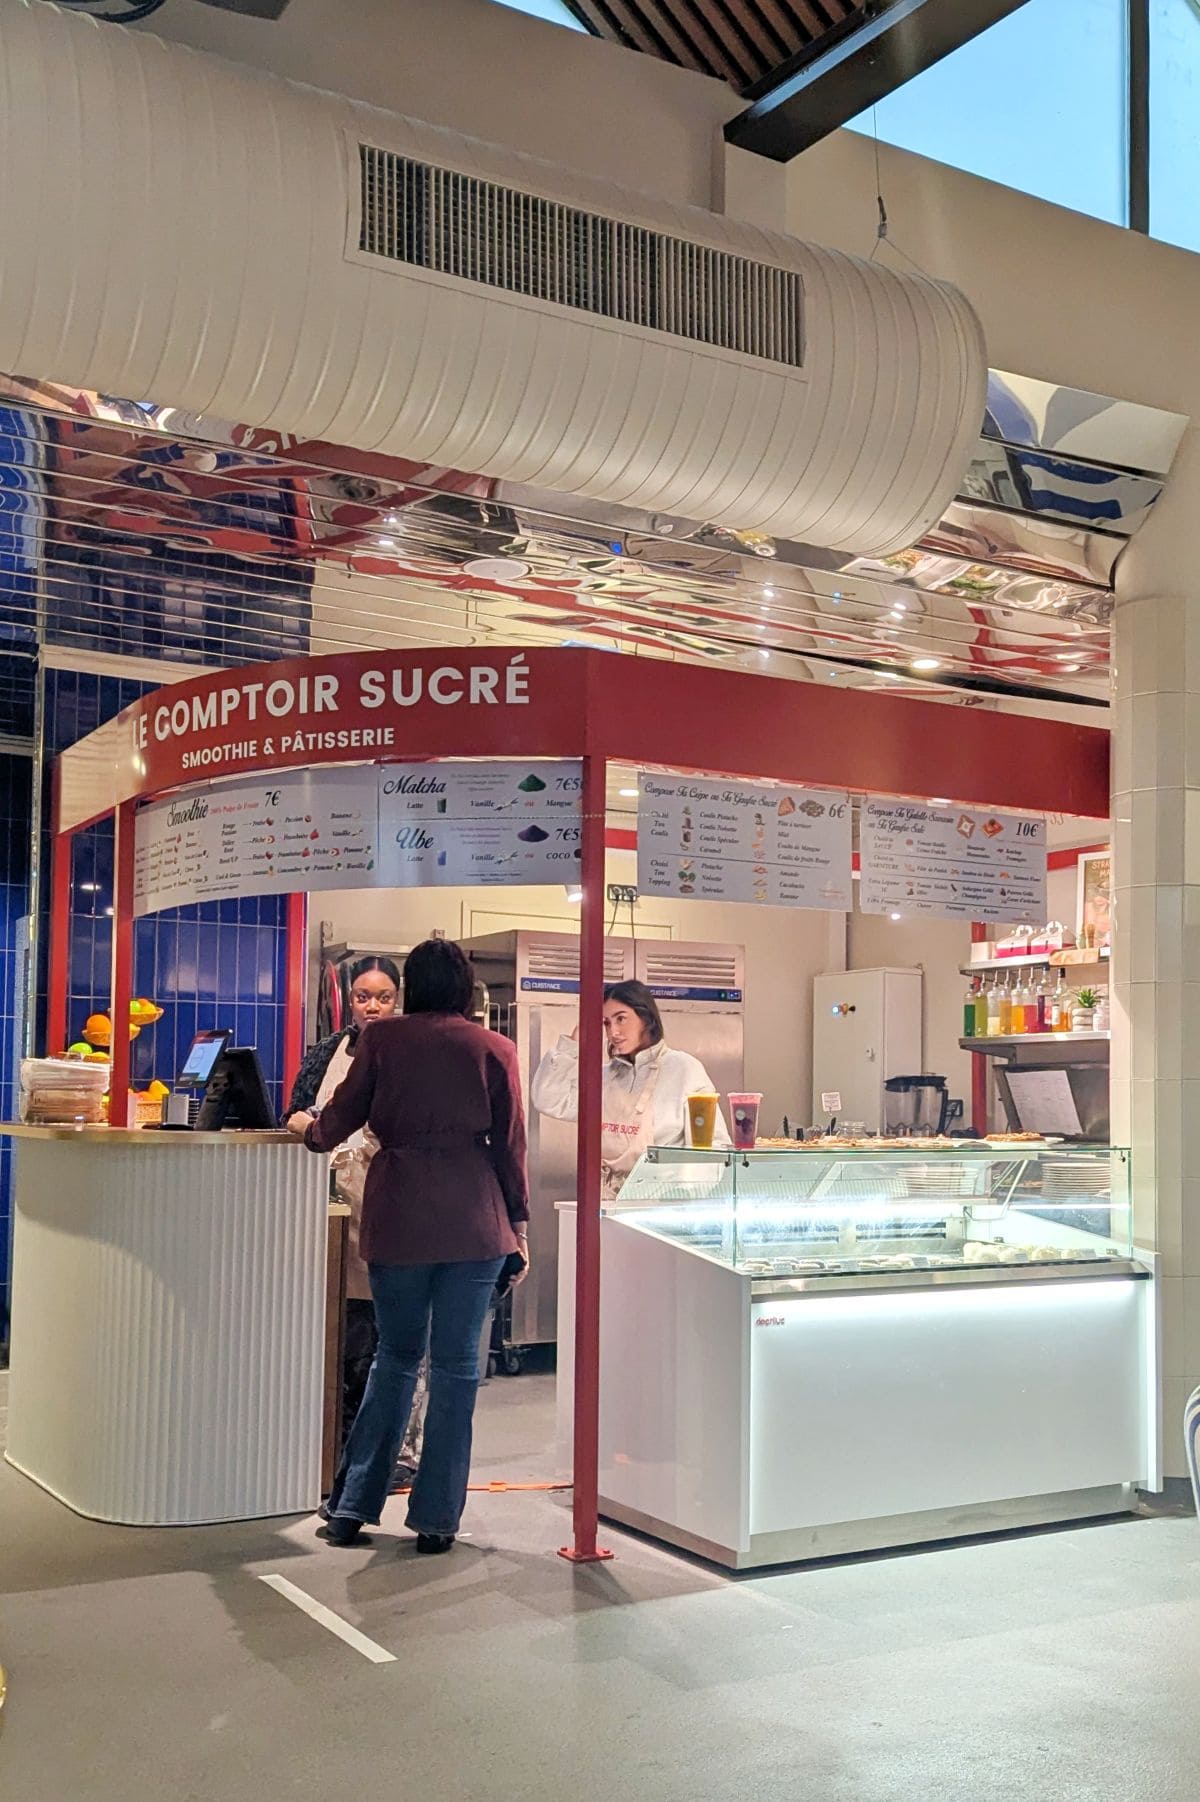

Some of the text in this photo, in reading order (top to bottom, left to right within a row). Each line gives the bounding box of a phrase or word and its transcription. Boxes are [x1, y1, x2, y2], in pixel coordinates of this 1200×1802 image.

[132, 653, 530, 752] LE COMPTOIR SUCRÉ
[182, 727, 395, 769] SMOOTHIE & PÂTISSERIE
[383, 775, 447, 794] Matcha
[555, 777, 583, 791] 7€5
[644, 782, 675, 798] Compose
[265, 790, 281, 807] 7€
[407, 801, 424, 809] Latte
[470, 800, 494, 808] Vanille
[546, 800, 573, 808] Mangue
[167, 798, 209, 827] Smoothie
[829, 803, 847, 818] 6€
[868, 804, 894, 817] Compose
[555, 828, 582, 841] 7€5
[1016, 822, 1039, 837] 10€
[396, 826, 435, 849] Ube
[546, 852, 570, 860] coco
[648, 877, 671, 886] Topping
